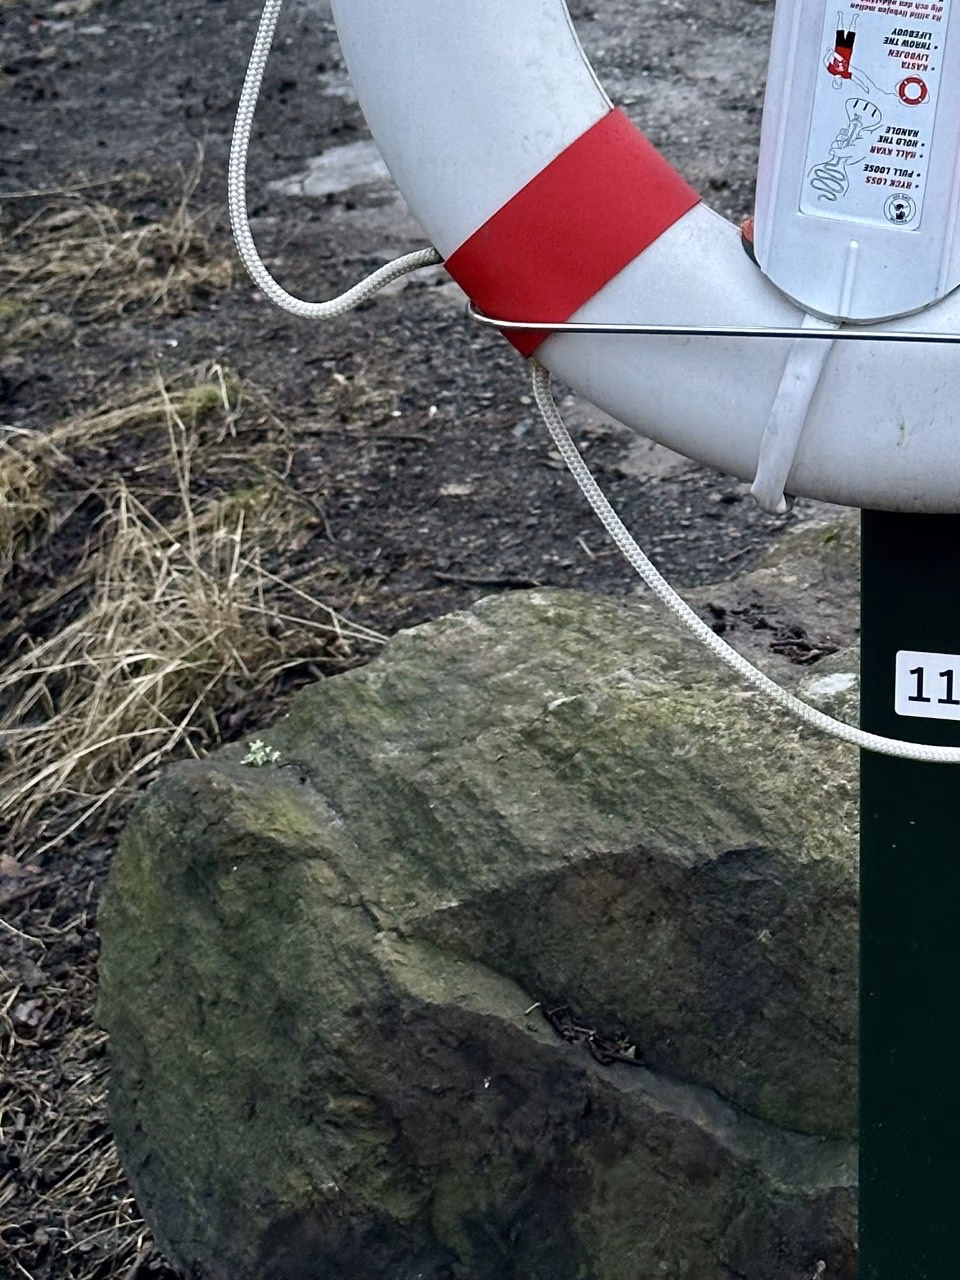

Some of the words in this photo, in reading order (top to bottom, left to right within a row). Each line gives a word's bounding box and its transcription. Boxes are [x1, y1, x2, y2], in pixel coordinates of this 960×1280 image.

[891, 28, 932, 40] LIFEBUOY
[883, 37, 899, 46] THE
[901, 40, 931, 50] THROW
[888, 50, 929, 61] LIVBOJEN
[901, 61, 928, 71] KASTA
[885, 126, 919, 137] HANDLE
[877, 135, 893, 144] THE
[896, 138, 918, 148] HOLD
[870, 146, 893, 156] KVAR
[896, 150, 916, 160] HÅLL
[863, 164, 890, 174] LOOSE
[894, 168, 914, 178] PULL
[865, 176, 887, 185] LOSS
